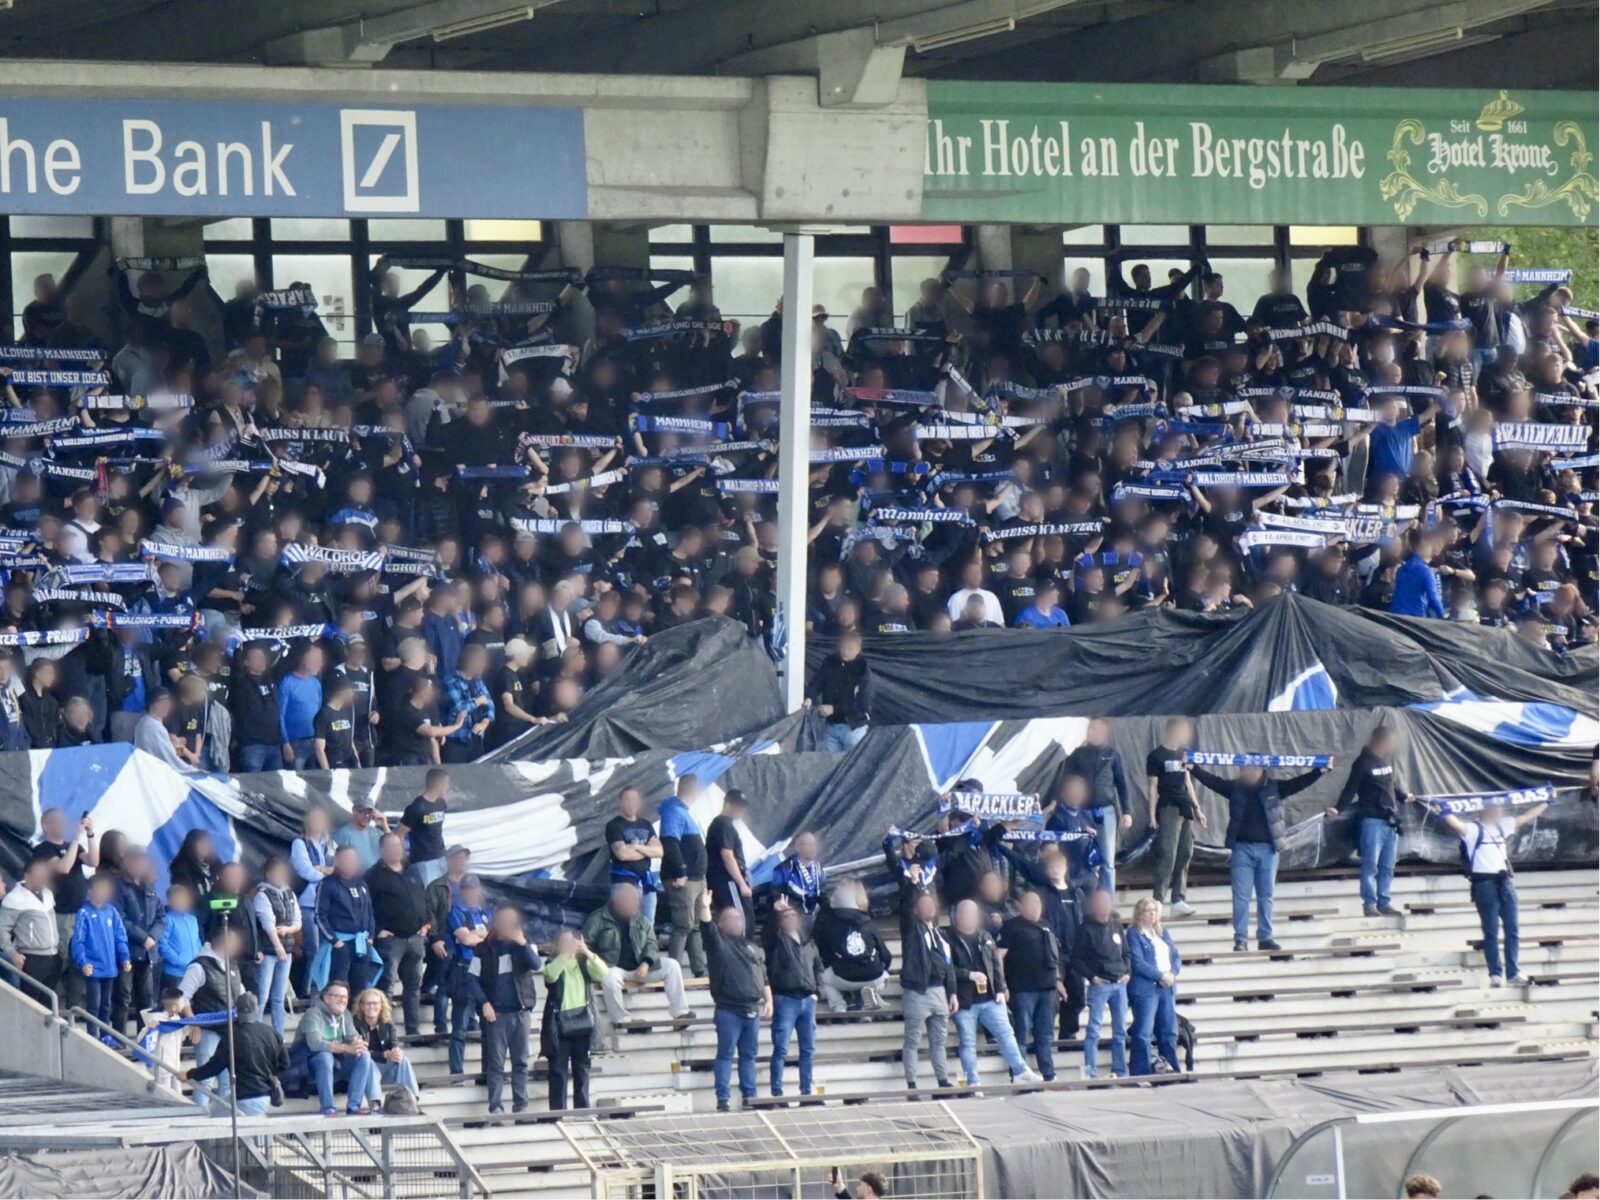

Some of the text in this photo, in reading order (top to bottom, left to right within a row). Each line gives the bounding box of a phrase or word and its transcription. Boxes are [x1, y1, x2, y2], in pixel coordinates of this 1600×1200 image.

[1450, 119, 1527, 134] Seit 1661
[122, 119, 297, 196] Bank
[980, 119, 1073, 177] Hotel
[1080, 137, 1119, 176] an
[1129, 121, 1180, 177] der
[1189, 121, 1366, 190] Bergstraße
[1427, 133, 1559, 176] Hotel Krone
[1521, 269, 1568, 282] MANNHEIM
[44, 349, 101, 361] MANNHEIM
[13, 370, 109, 384] DU BIST UNSER IDEAL
[655, 416, 713, 431] MANNHEIM
[833, 446, 883, 461] MANNHEIM
[723, 479, 759, 491] WALDHOF
[1196, 472, 1288, 485] WALDHOF MANNHEIM
[876, 507, 963, 523] Mannheim
[142, 540, 230, 562] WALDHOF MANNHEIM
[303, 543, 370, 564] WALDHOF
[114, 615, 191, 627] WALDHOF-POWER
[1193, 751, 1236, 766] SVW
[1278, 755, 1317, 767] 1907
[1446, 787, 1550, 813] ULT RAS
